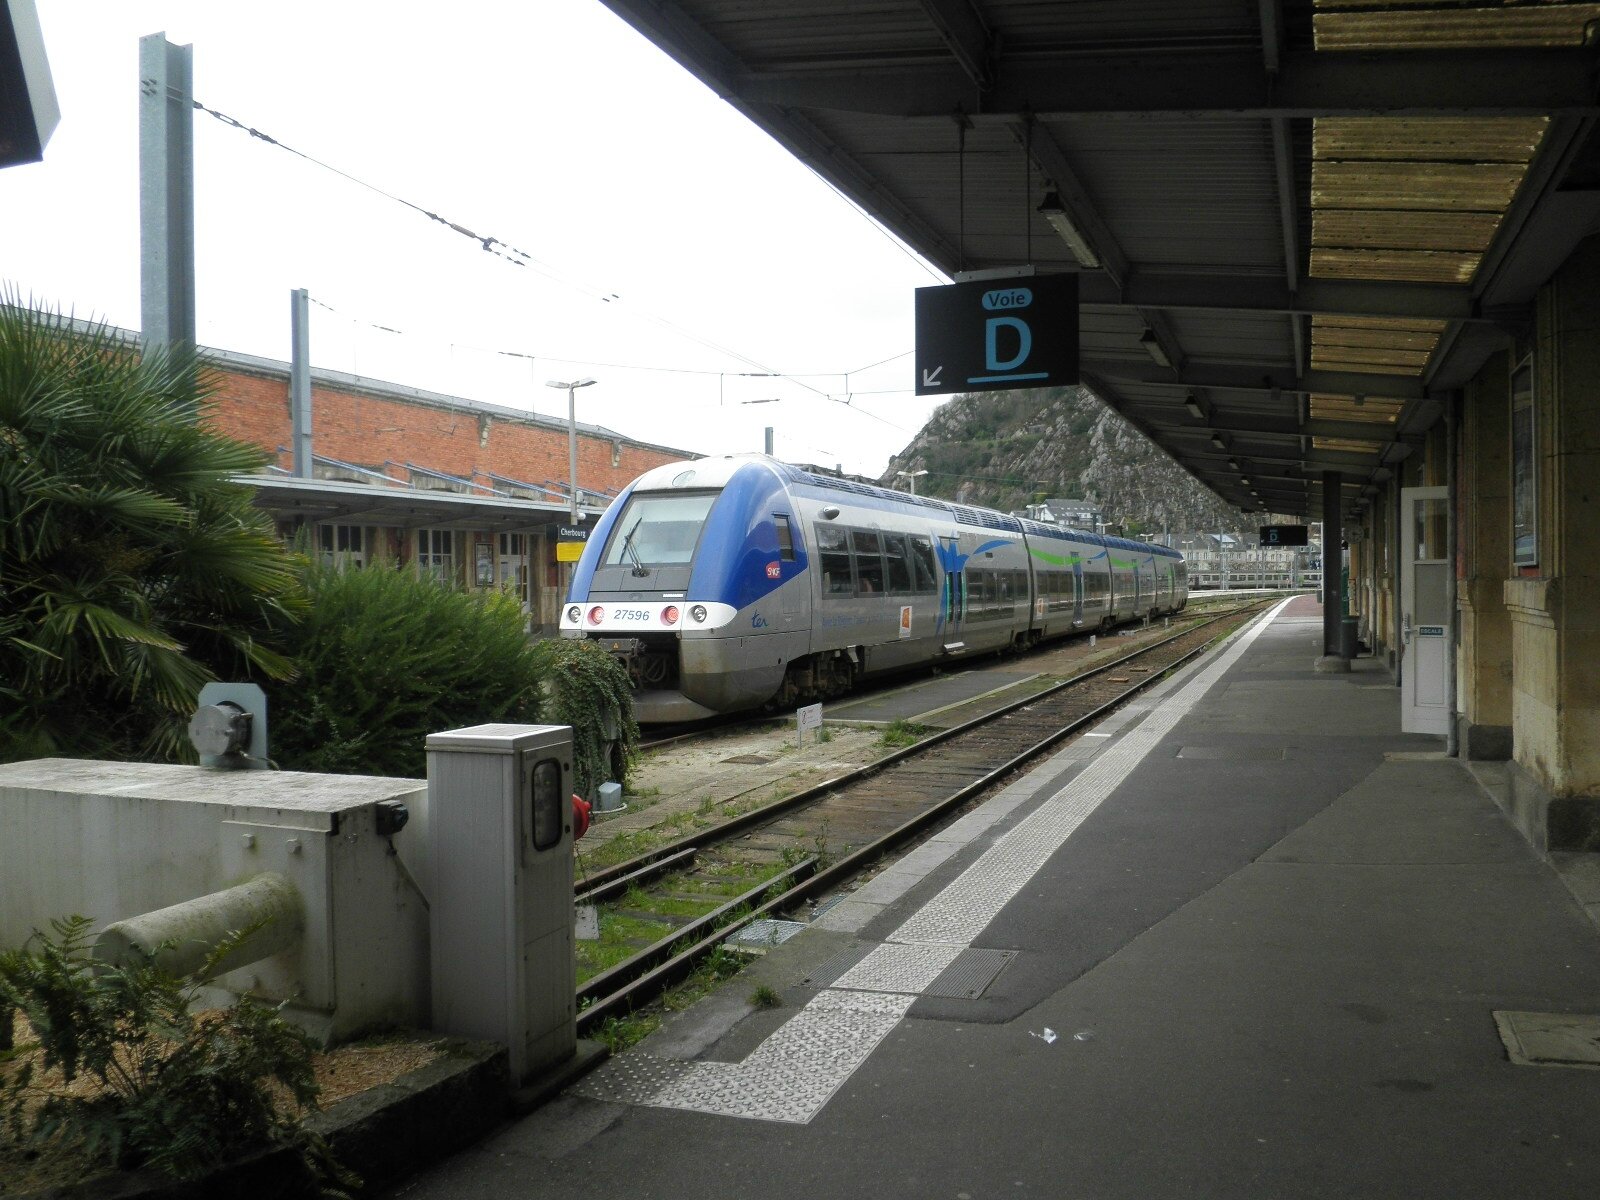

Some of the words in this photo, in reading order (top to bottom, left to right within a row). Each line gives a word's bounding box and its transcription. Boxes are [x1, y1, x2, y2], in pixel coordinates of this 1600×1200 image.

[988, 291, 1025, 307] Voie
[986, 316, 1032, 371] D
[560, 527, 586, 538] Cherbourg
[613, 609, 650, 621] 27596
